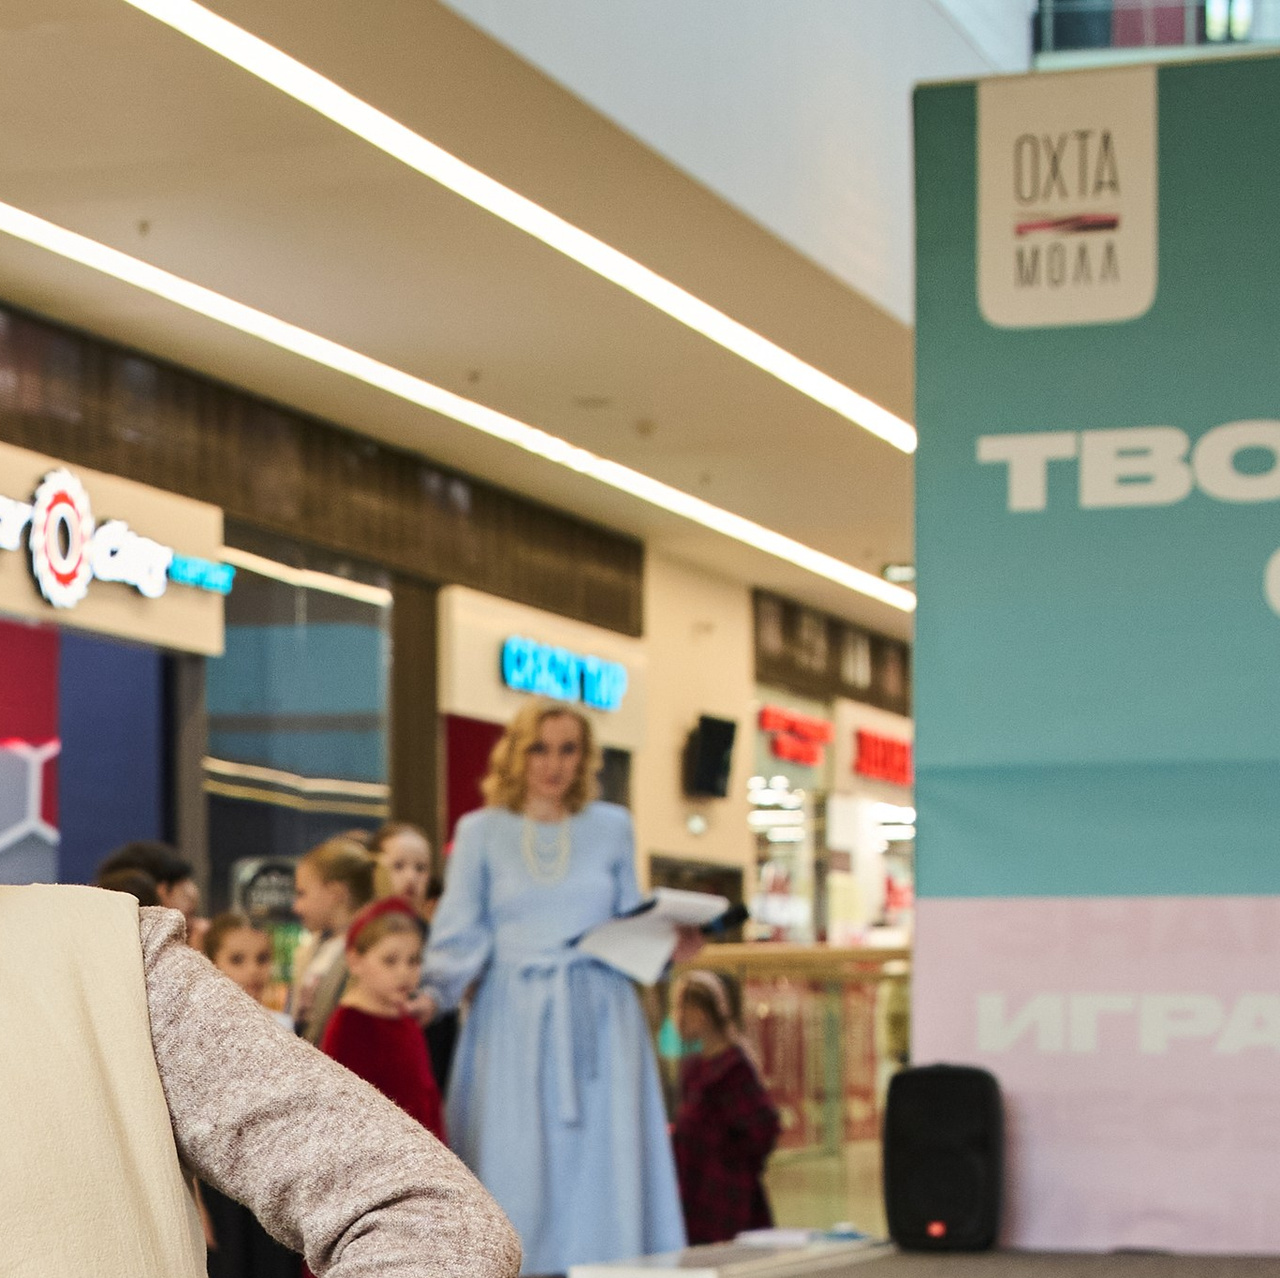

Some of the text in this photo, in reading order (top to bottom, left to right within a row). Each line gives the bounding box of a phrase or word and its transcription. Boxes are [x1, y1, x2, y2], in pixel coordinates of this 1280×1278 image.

[1015, 130, 1120, 204] ОХТА
[977, 419, 1280, 511] ТВО
[976, 992, 1280, 1054] ИГРА
